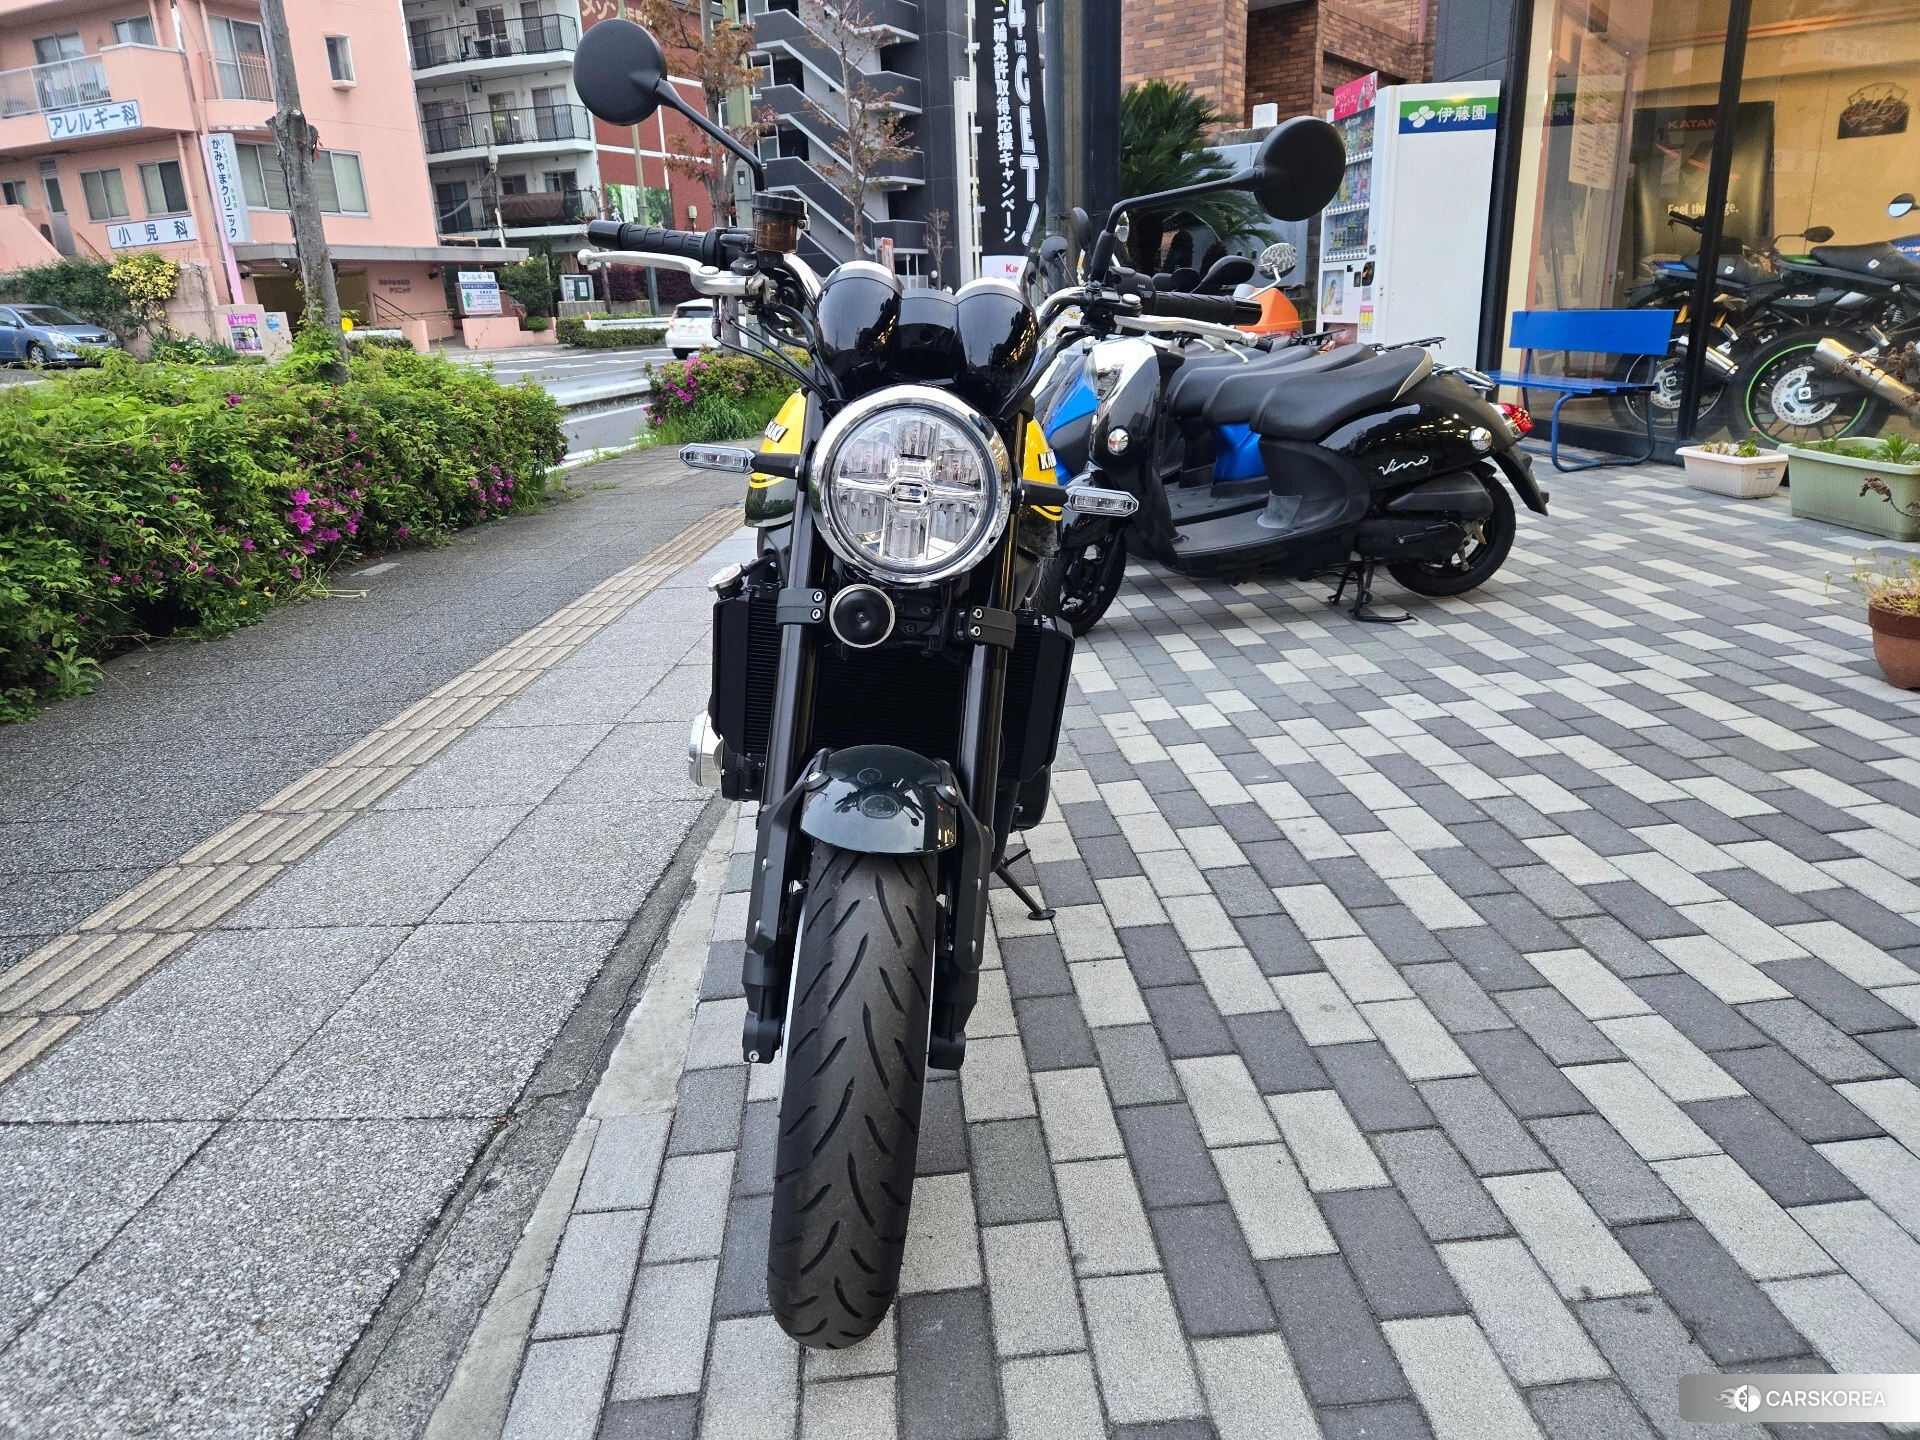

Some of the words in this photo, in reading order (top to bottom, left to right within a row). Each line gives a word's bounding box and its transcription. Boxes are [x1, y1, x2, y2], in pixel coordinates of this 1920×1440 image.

[50, 103, 138, 137] アレルギー科
[993, 6, 1016, 243] 二輪免許取得応援キャンペーン
[1436, 104, 1487, 124] 伊藤園
[1667, 118, 1717, 129] KATAN
[212, 138, 237, 238] かみやまクリニック
[117, 219, 189, 245] 小児科
[1378, 455, 1429, 476] Vino
